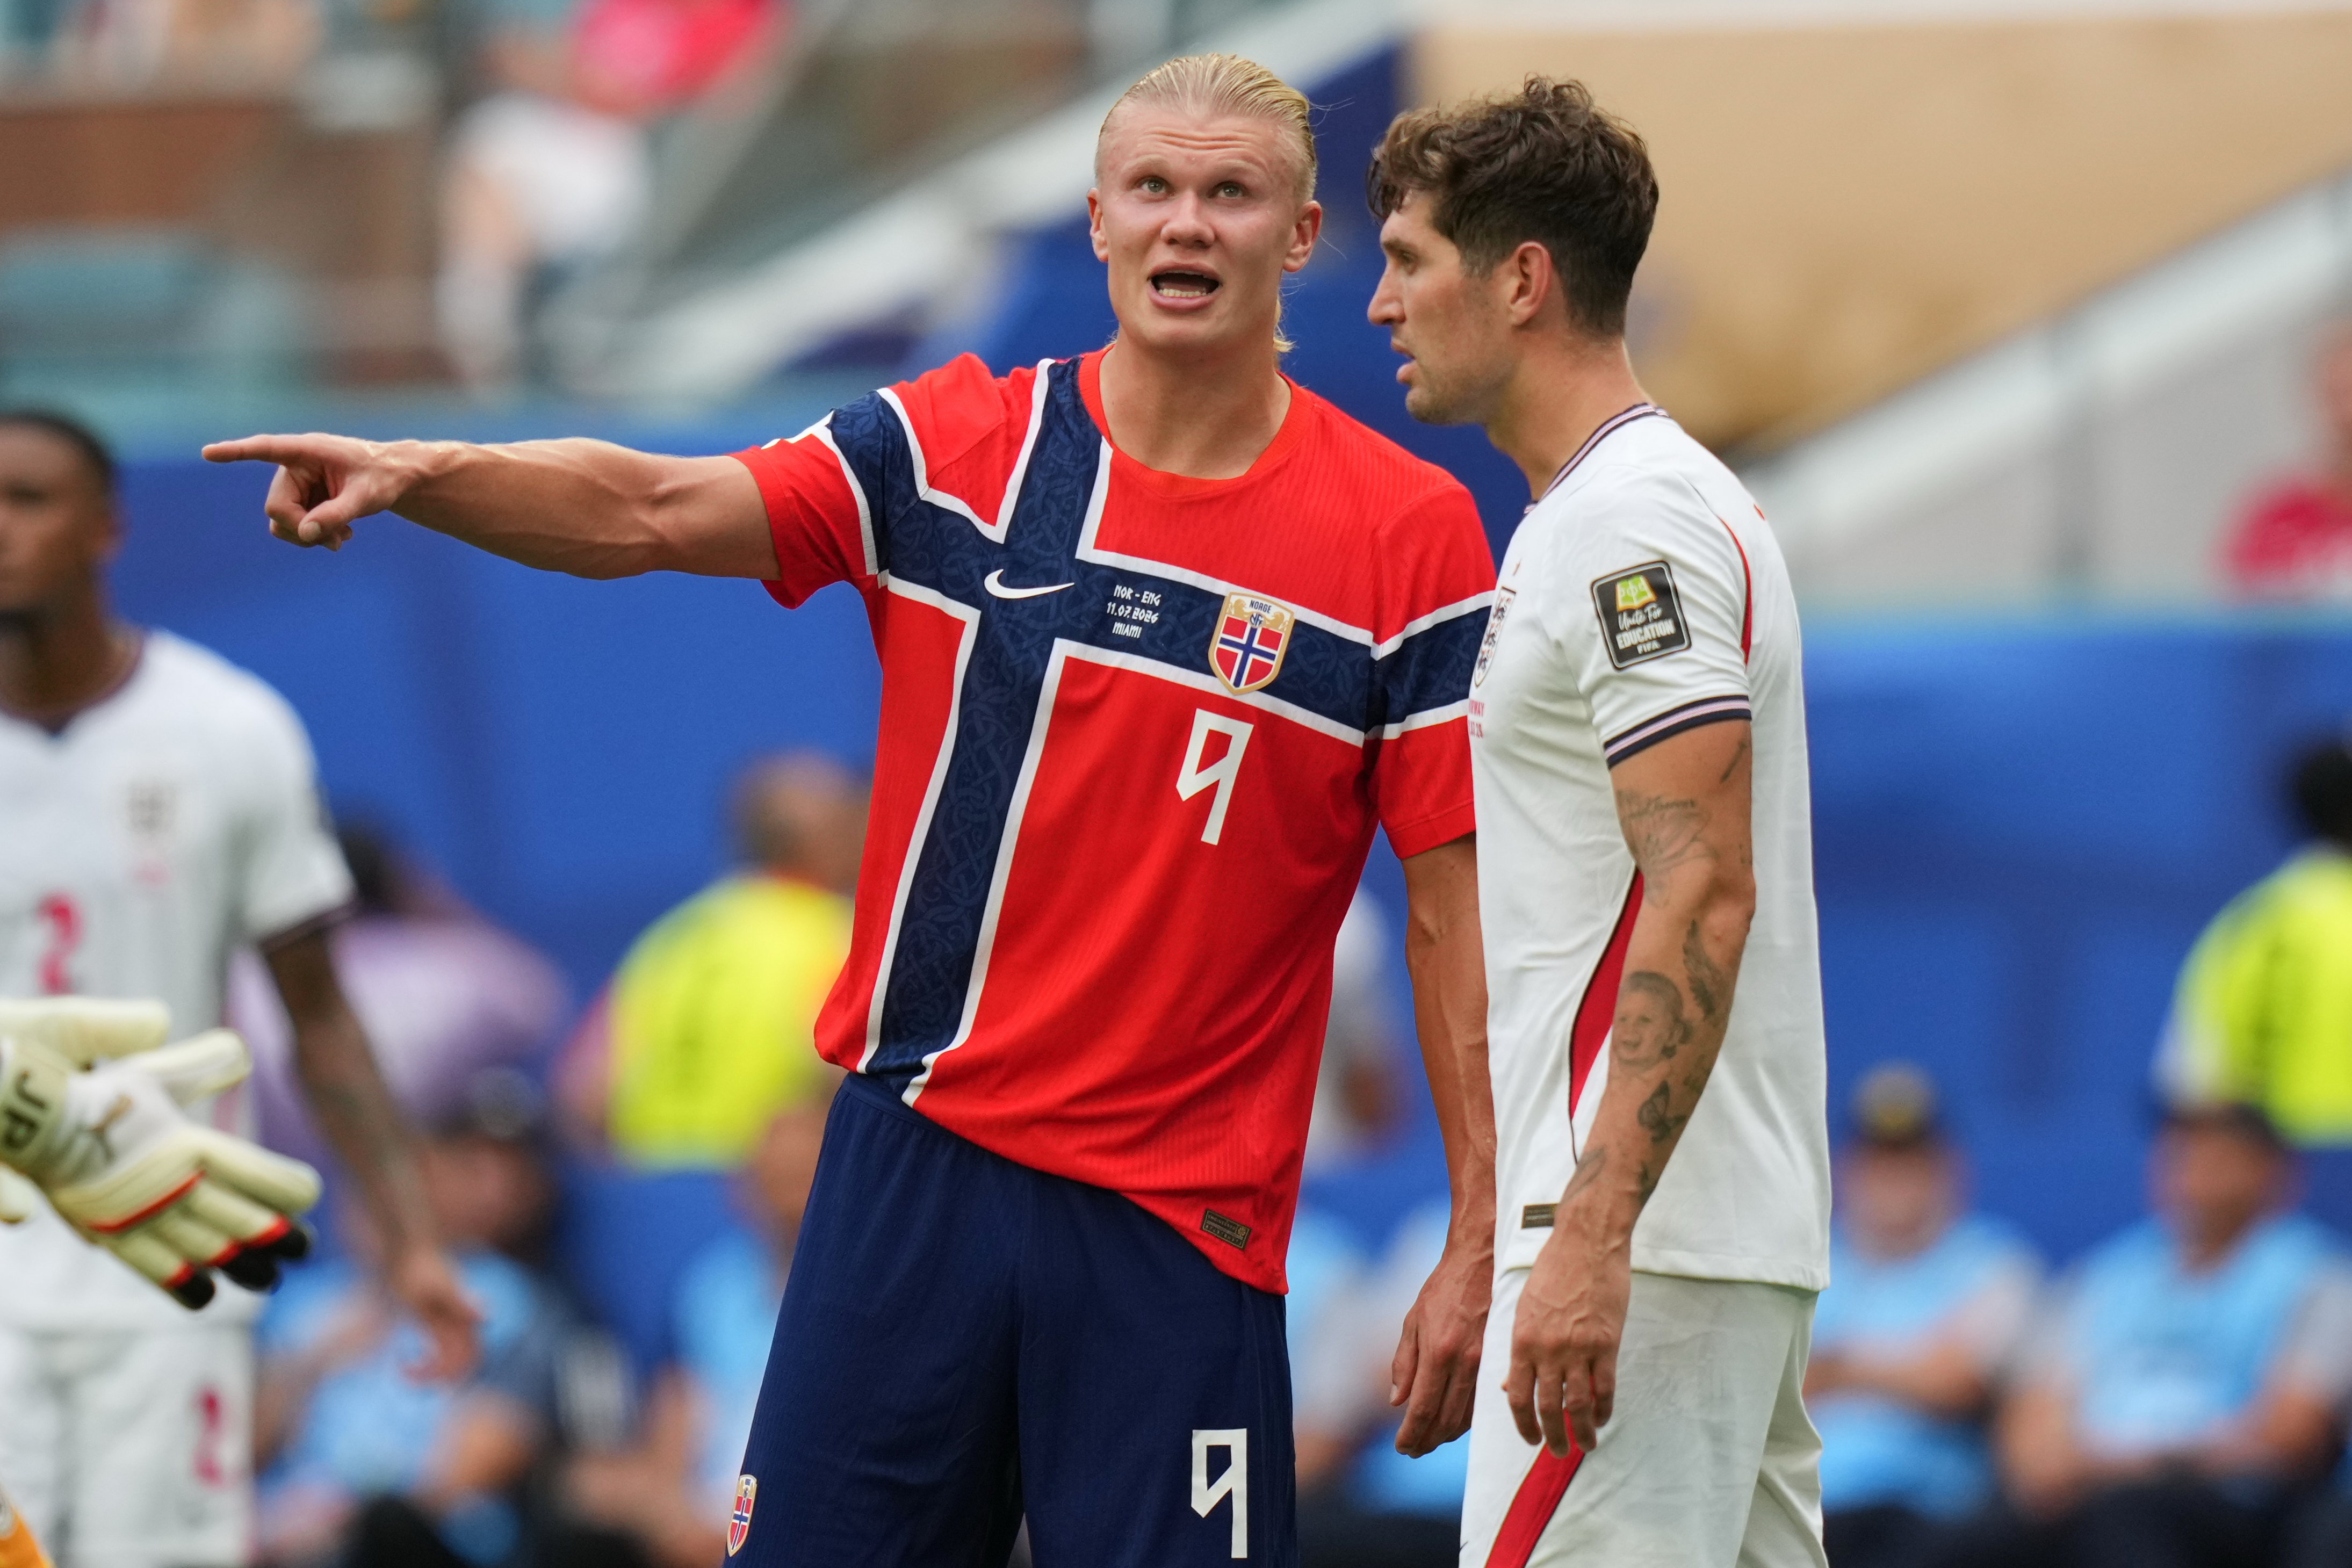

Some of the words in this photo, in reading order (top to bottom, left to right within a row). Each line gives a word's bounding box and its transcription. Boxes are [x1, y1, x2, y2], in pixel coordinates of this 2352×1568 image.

[1114, 584, 1134, 600] NOR
[1141, 590, 1161, 606] ENG
[1249, 599, 1272, 613] NORGE
[1107, 602, 1159, 624] 11.07.2026
[1112, 622, 1142, 639] MIAMI
[1615, 618, 1676, 650] EDUCATION
[1175, 707, 1255, 846] 9
[34, 887, 86, 998] 2
[1191, 1428, 1247, 1559] 9
